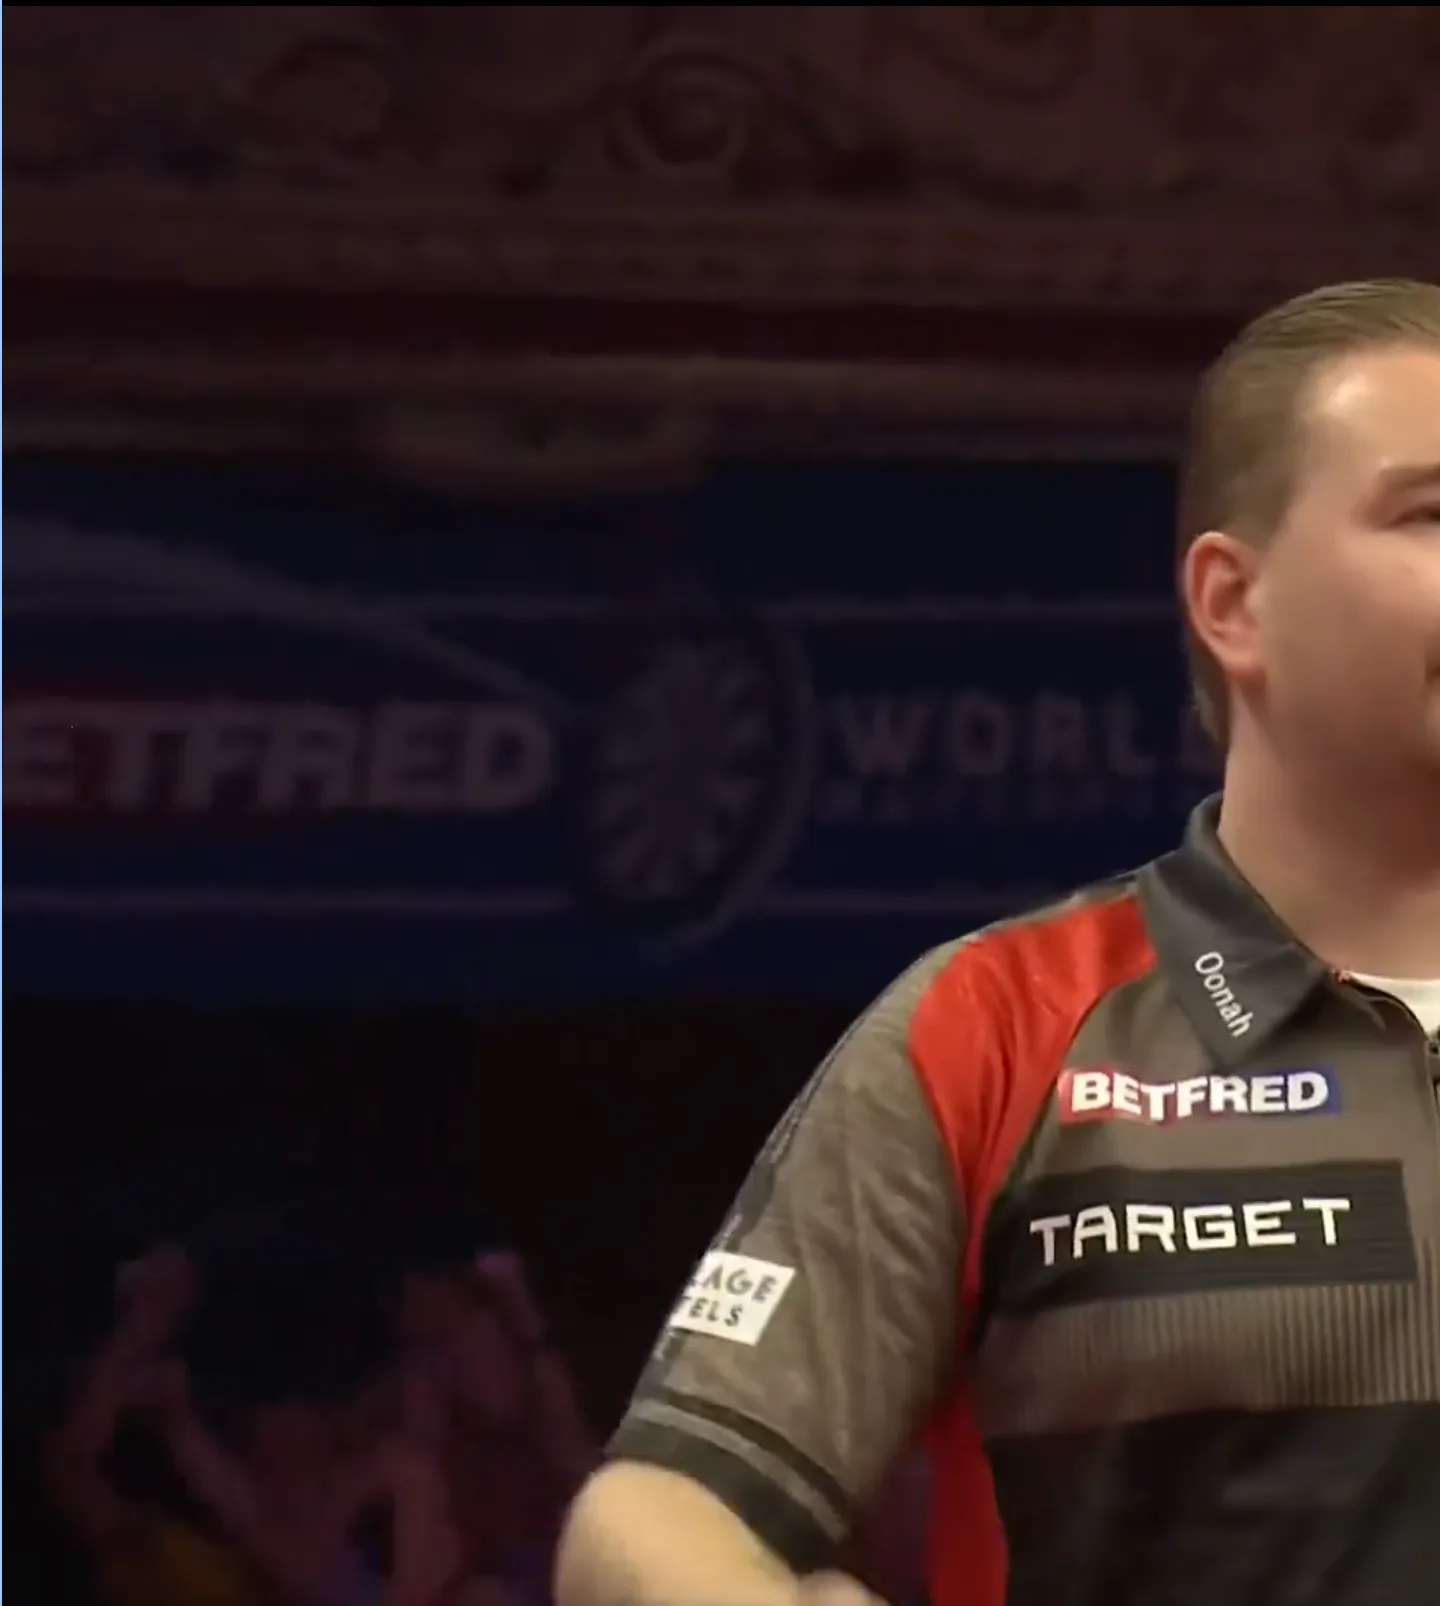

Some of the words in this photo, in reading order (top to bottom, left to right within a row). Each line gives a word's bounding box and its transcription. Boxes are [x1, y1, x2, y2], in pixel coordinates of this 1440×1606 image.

[1194, 951, 1254, 1037] Oonah
[1071, 1071, 1329, 1121] BETFRED
[1029, 1197, 1350, 1266] TARGET
[690, 1264, 779, 1303] AGE
[681, 1295, 743, 1327] ELS
